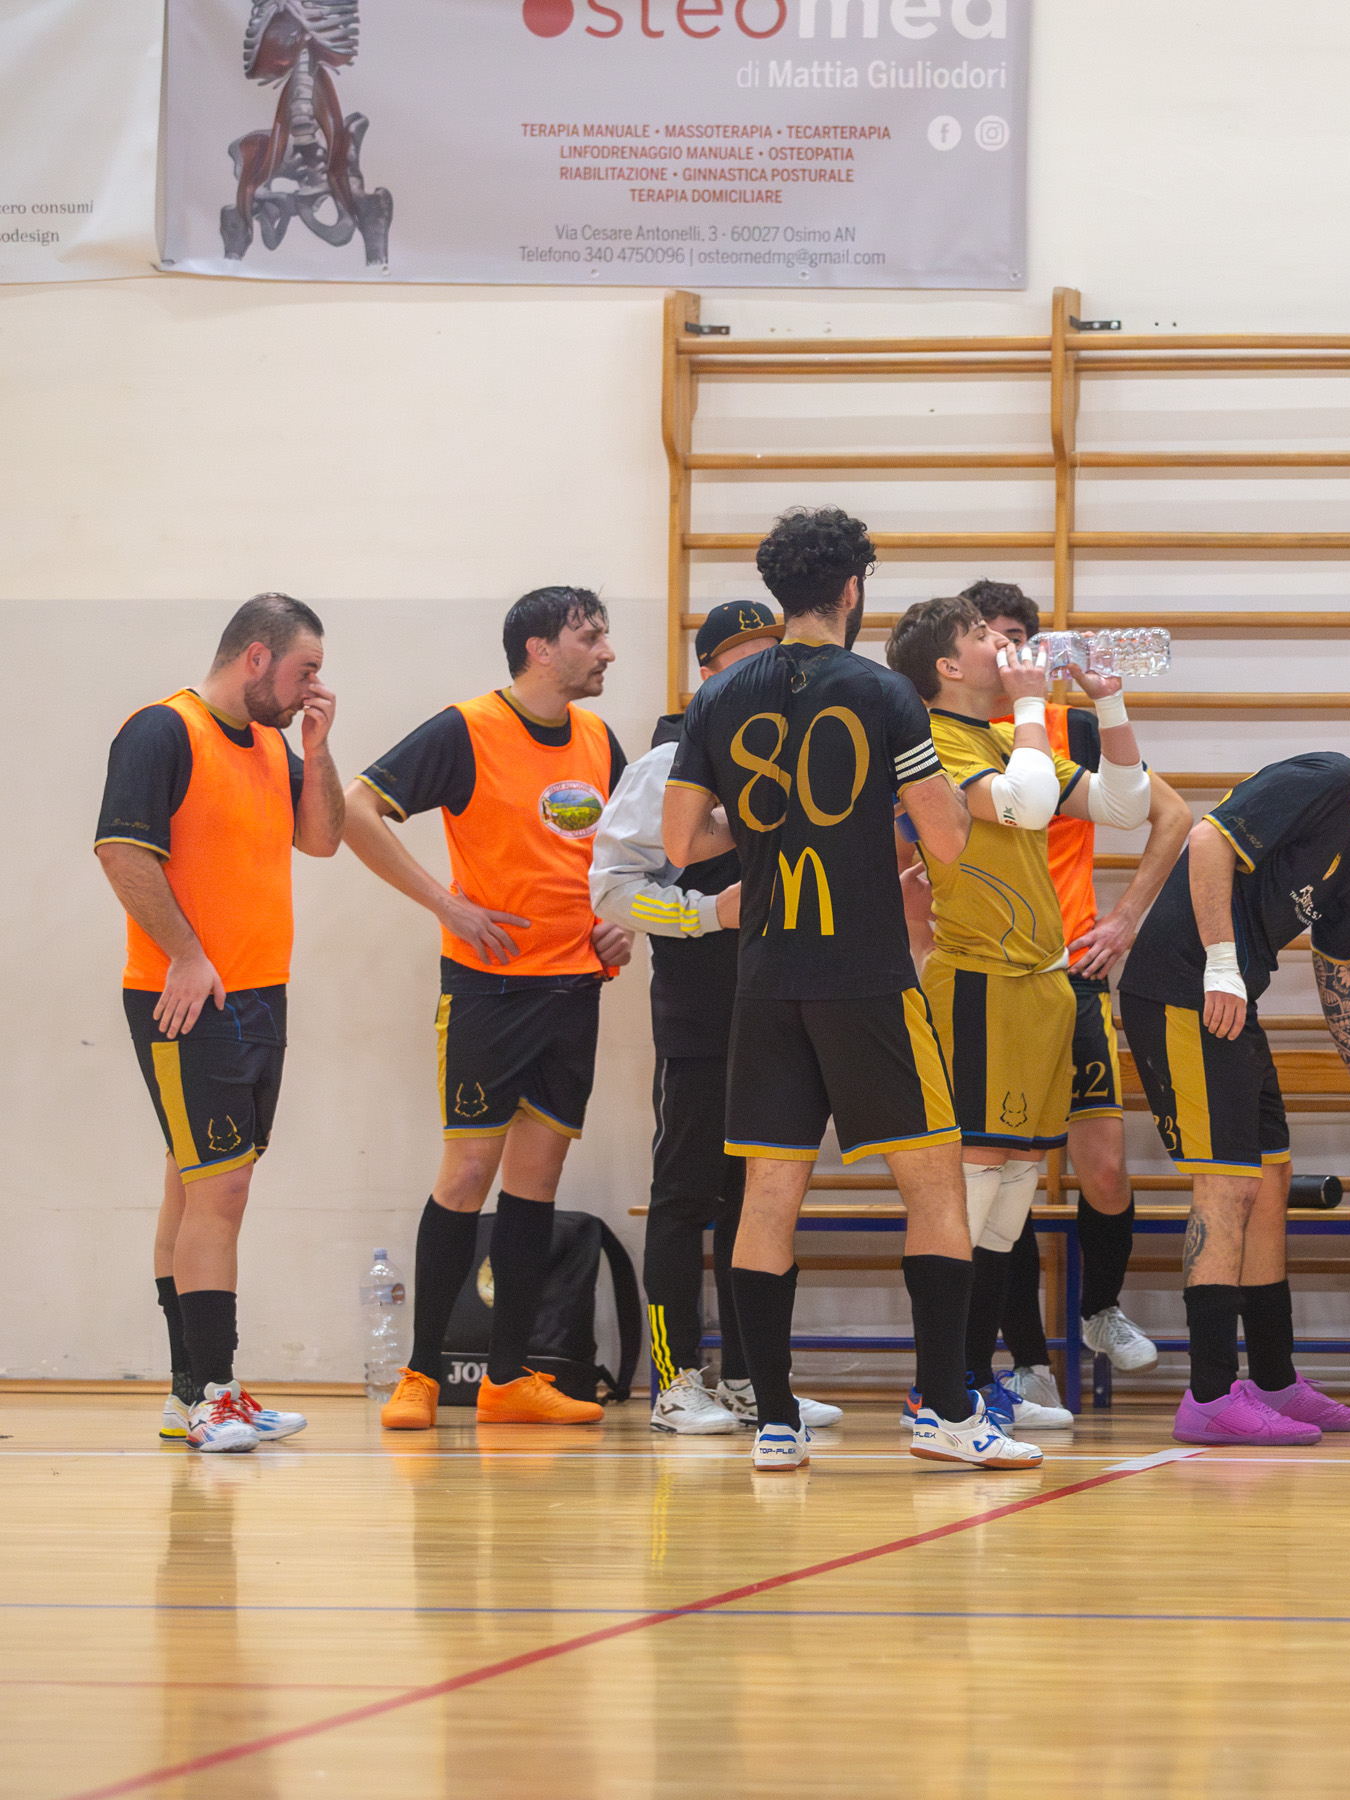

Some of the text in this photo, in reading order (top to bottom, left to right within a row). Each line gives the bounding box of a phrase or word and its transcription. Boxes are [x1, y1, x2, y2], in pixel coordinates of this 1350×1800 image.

[736, 60, 1007, 89] di Mattia Giuliodori
[521, 123, 892, 140] TERAPIA MANUALE MASSOTERAPIA TECARTERAPIA
[559, 145, 855, 161] LINFODRENAGGIO MANUALE OSTEOPATIA
[559, 166, 855, 183] RIABILITAZIONE GINNASTICA POSTURALE
[629, 188, 783, 204] TERAPIA DOMICILIARE
[0, 200, 94, 214] ero consumi
[0, 228, 60, 247] odesign
[555, 224, 578, 240] Via
[581, 224, 633, 241] Cesare
[708, 226, 719, 242] 3
[730, 226, 780, 242] 60027
[783, 226, 831, 242] Osimo
[834, 227, 856, 242] AN
[519, 246, 886, 269] Telefono 340 4750096 osteomedmg@gmail.com
[730, 706, 870, 833] 80
[759, 1447, 797, 1455] TOP-FLEX
